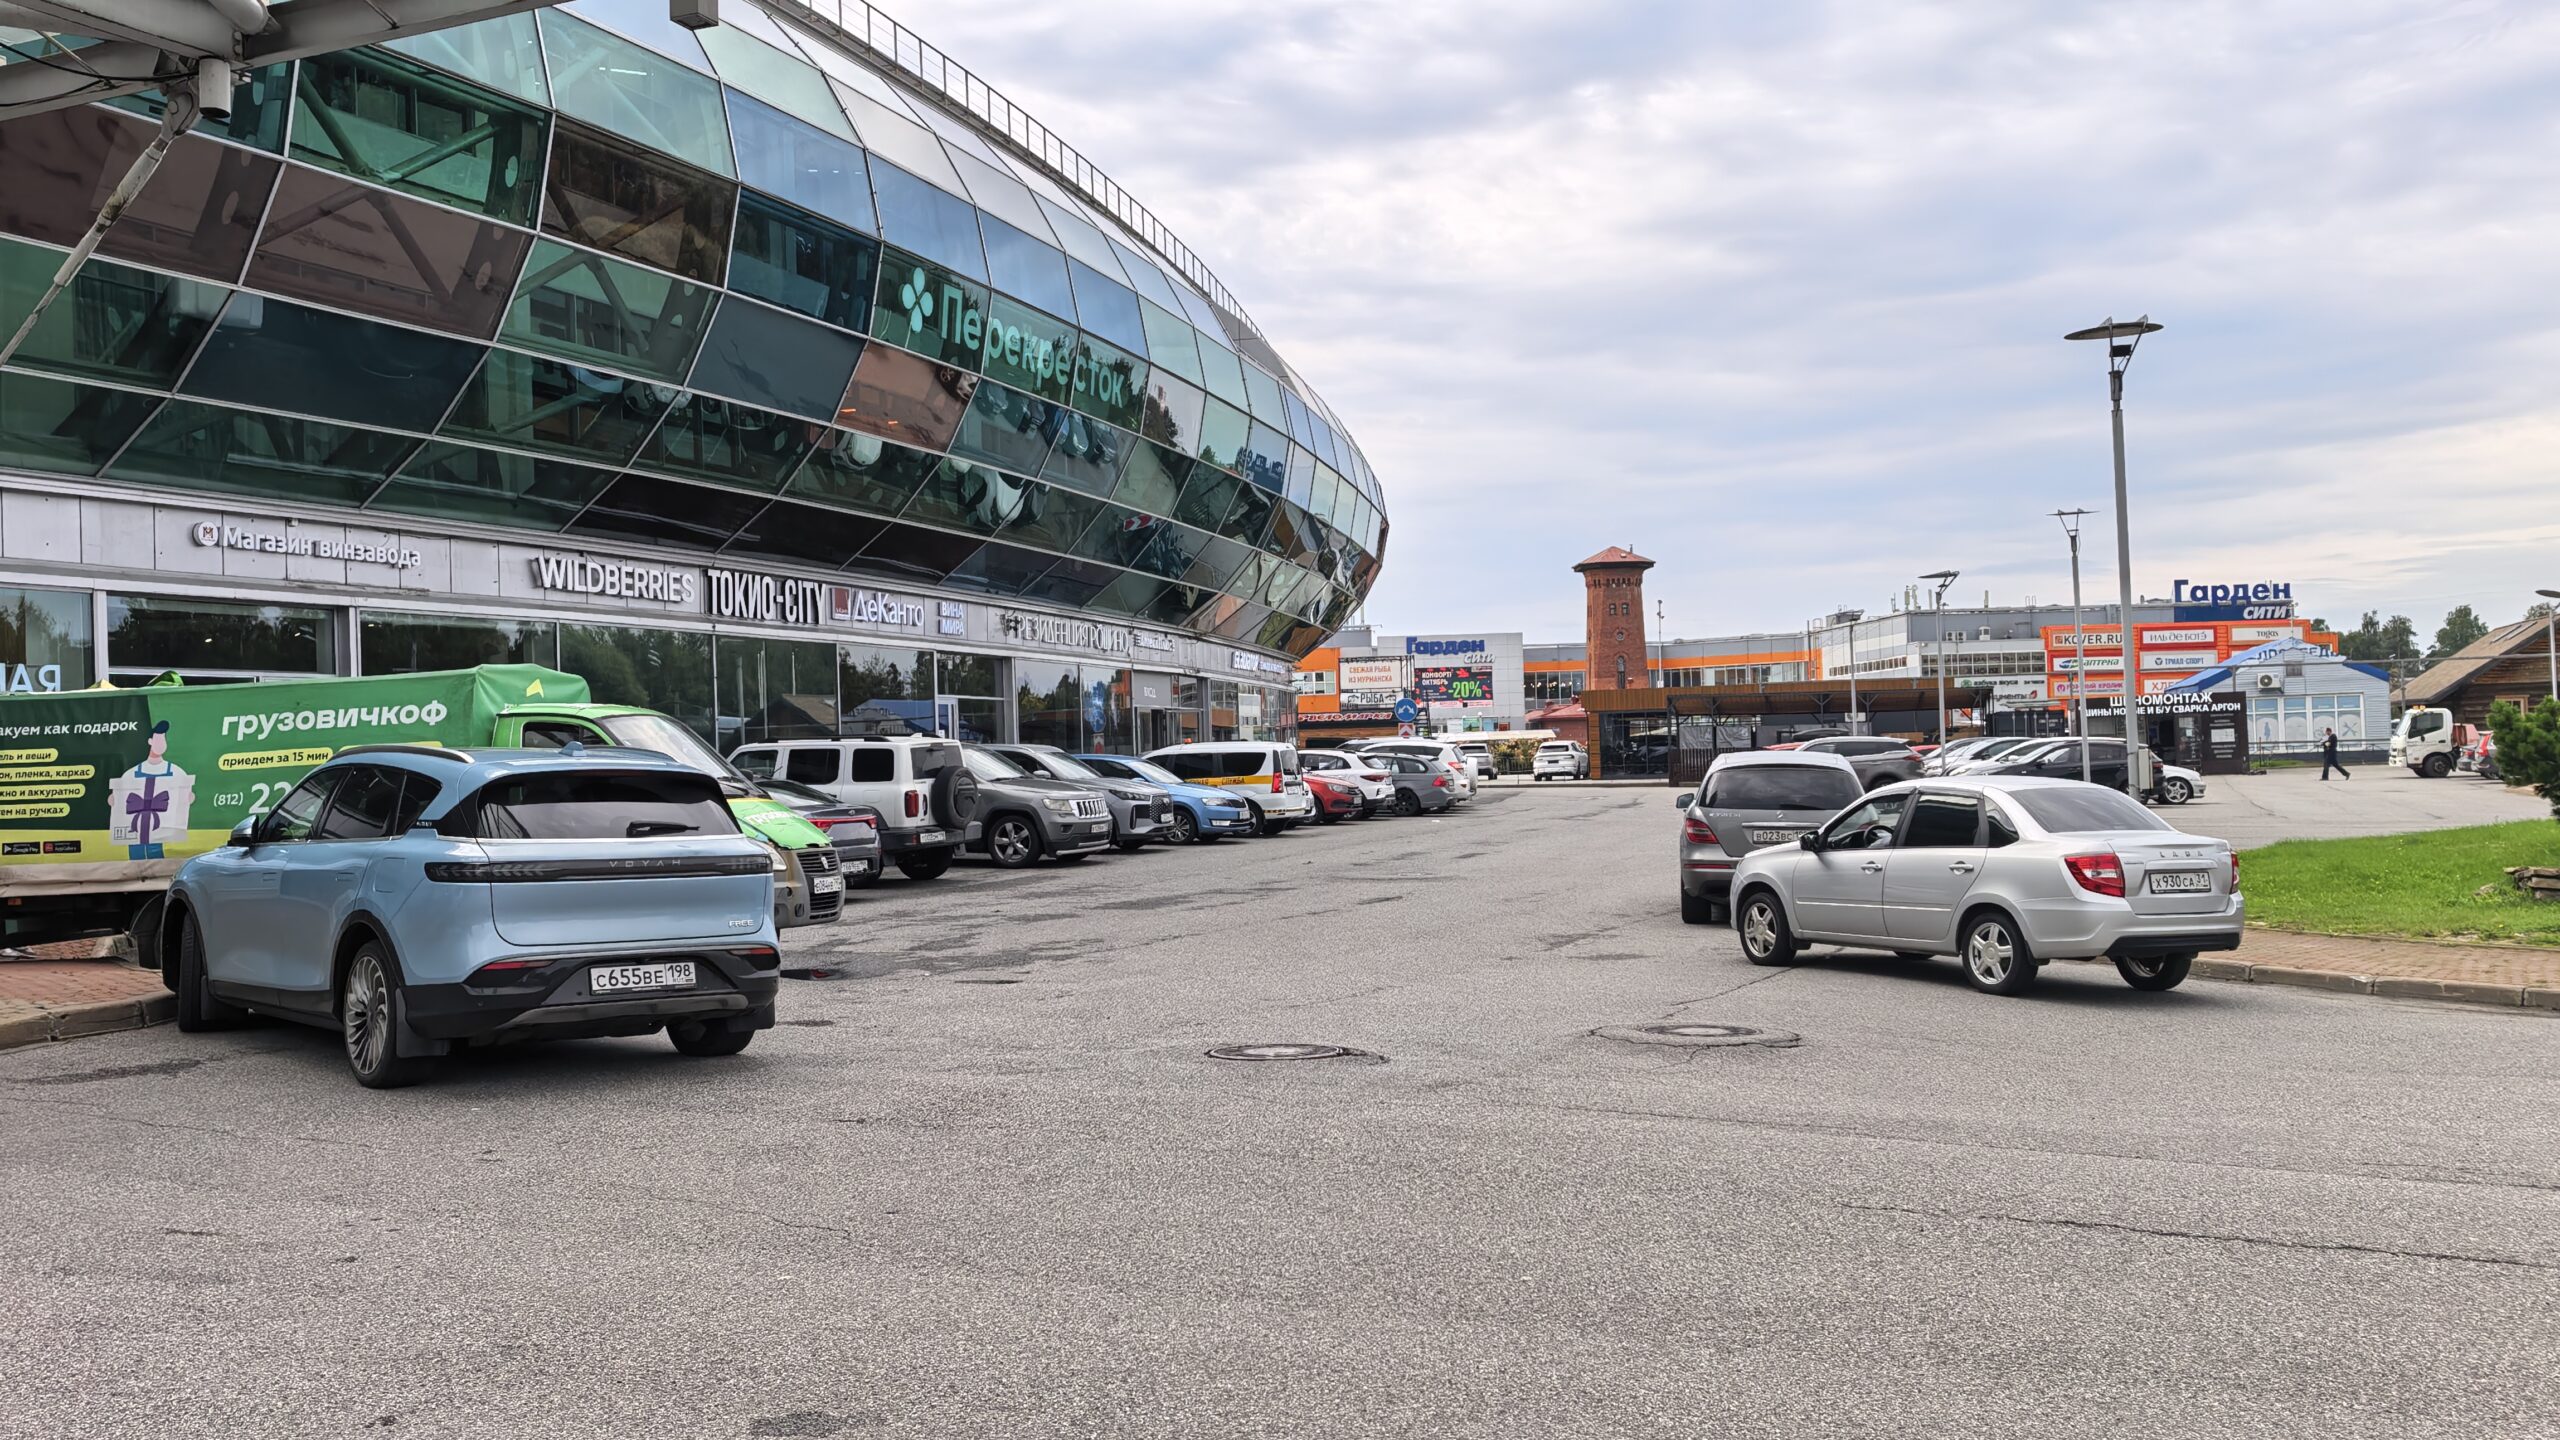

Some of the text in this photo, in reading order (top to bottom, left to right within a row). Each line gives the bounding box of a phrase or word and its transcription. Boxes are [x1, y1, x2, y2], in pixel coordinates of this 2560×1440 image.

[223, 526, 421, 569] Магазин винзавода
[538, 555, 695, 602] WILDBERRIES
[2174, 580, 2291, 607] Гарден
[853, 590, 925, 627] ДеКанто
[941, 602, 964, 619] ВИНА
[2242, 605, 2288, 620] СИТИ
[941, 619, 964, 636] МИРА
[1018, 615, 1089, 647] РЕЗИДЕНЦИЯ
[1406, 636, 1485, 656] Гарден
[2064, 634, 2123, 645] KOVER.RU
[1374, 665, 1391, 673] РЫБА
[1358, 675, 1393, 684] МУРМАНСКА
[1448, 681, 1482, 699] -20%
[1360, 693, 1384, 704] РЫБА
[2172, 703, 2210, 714] СВАРКА
[2210, 702, 2241, 712] АРГОН
[221, 700, 448, 741] грузовичкоф
[44, 724, 70, 735] как
[74, 721, 138, 735] подарок
[25, 752, 52, 760] вещи
[222, 752, 329, 769] приедем за 15 мин
[15, 771, 53, 779] пленка,
[55, 768, 91, 777] каркас
[20, 789, 26, 797] и
[28, 787, 81, 798] аккуратно
[213, 792, 243, 807] (812)
[15, 808, 27, 816] на
[29, 807, 65, 818] ручках
[608, 858, 681, 868] VOYAH
[728, 919, 755, 928] FREE
[667, 964, 690, 978] 198
